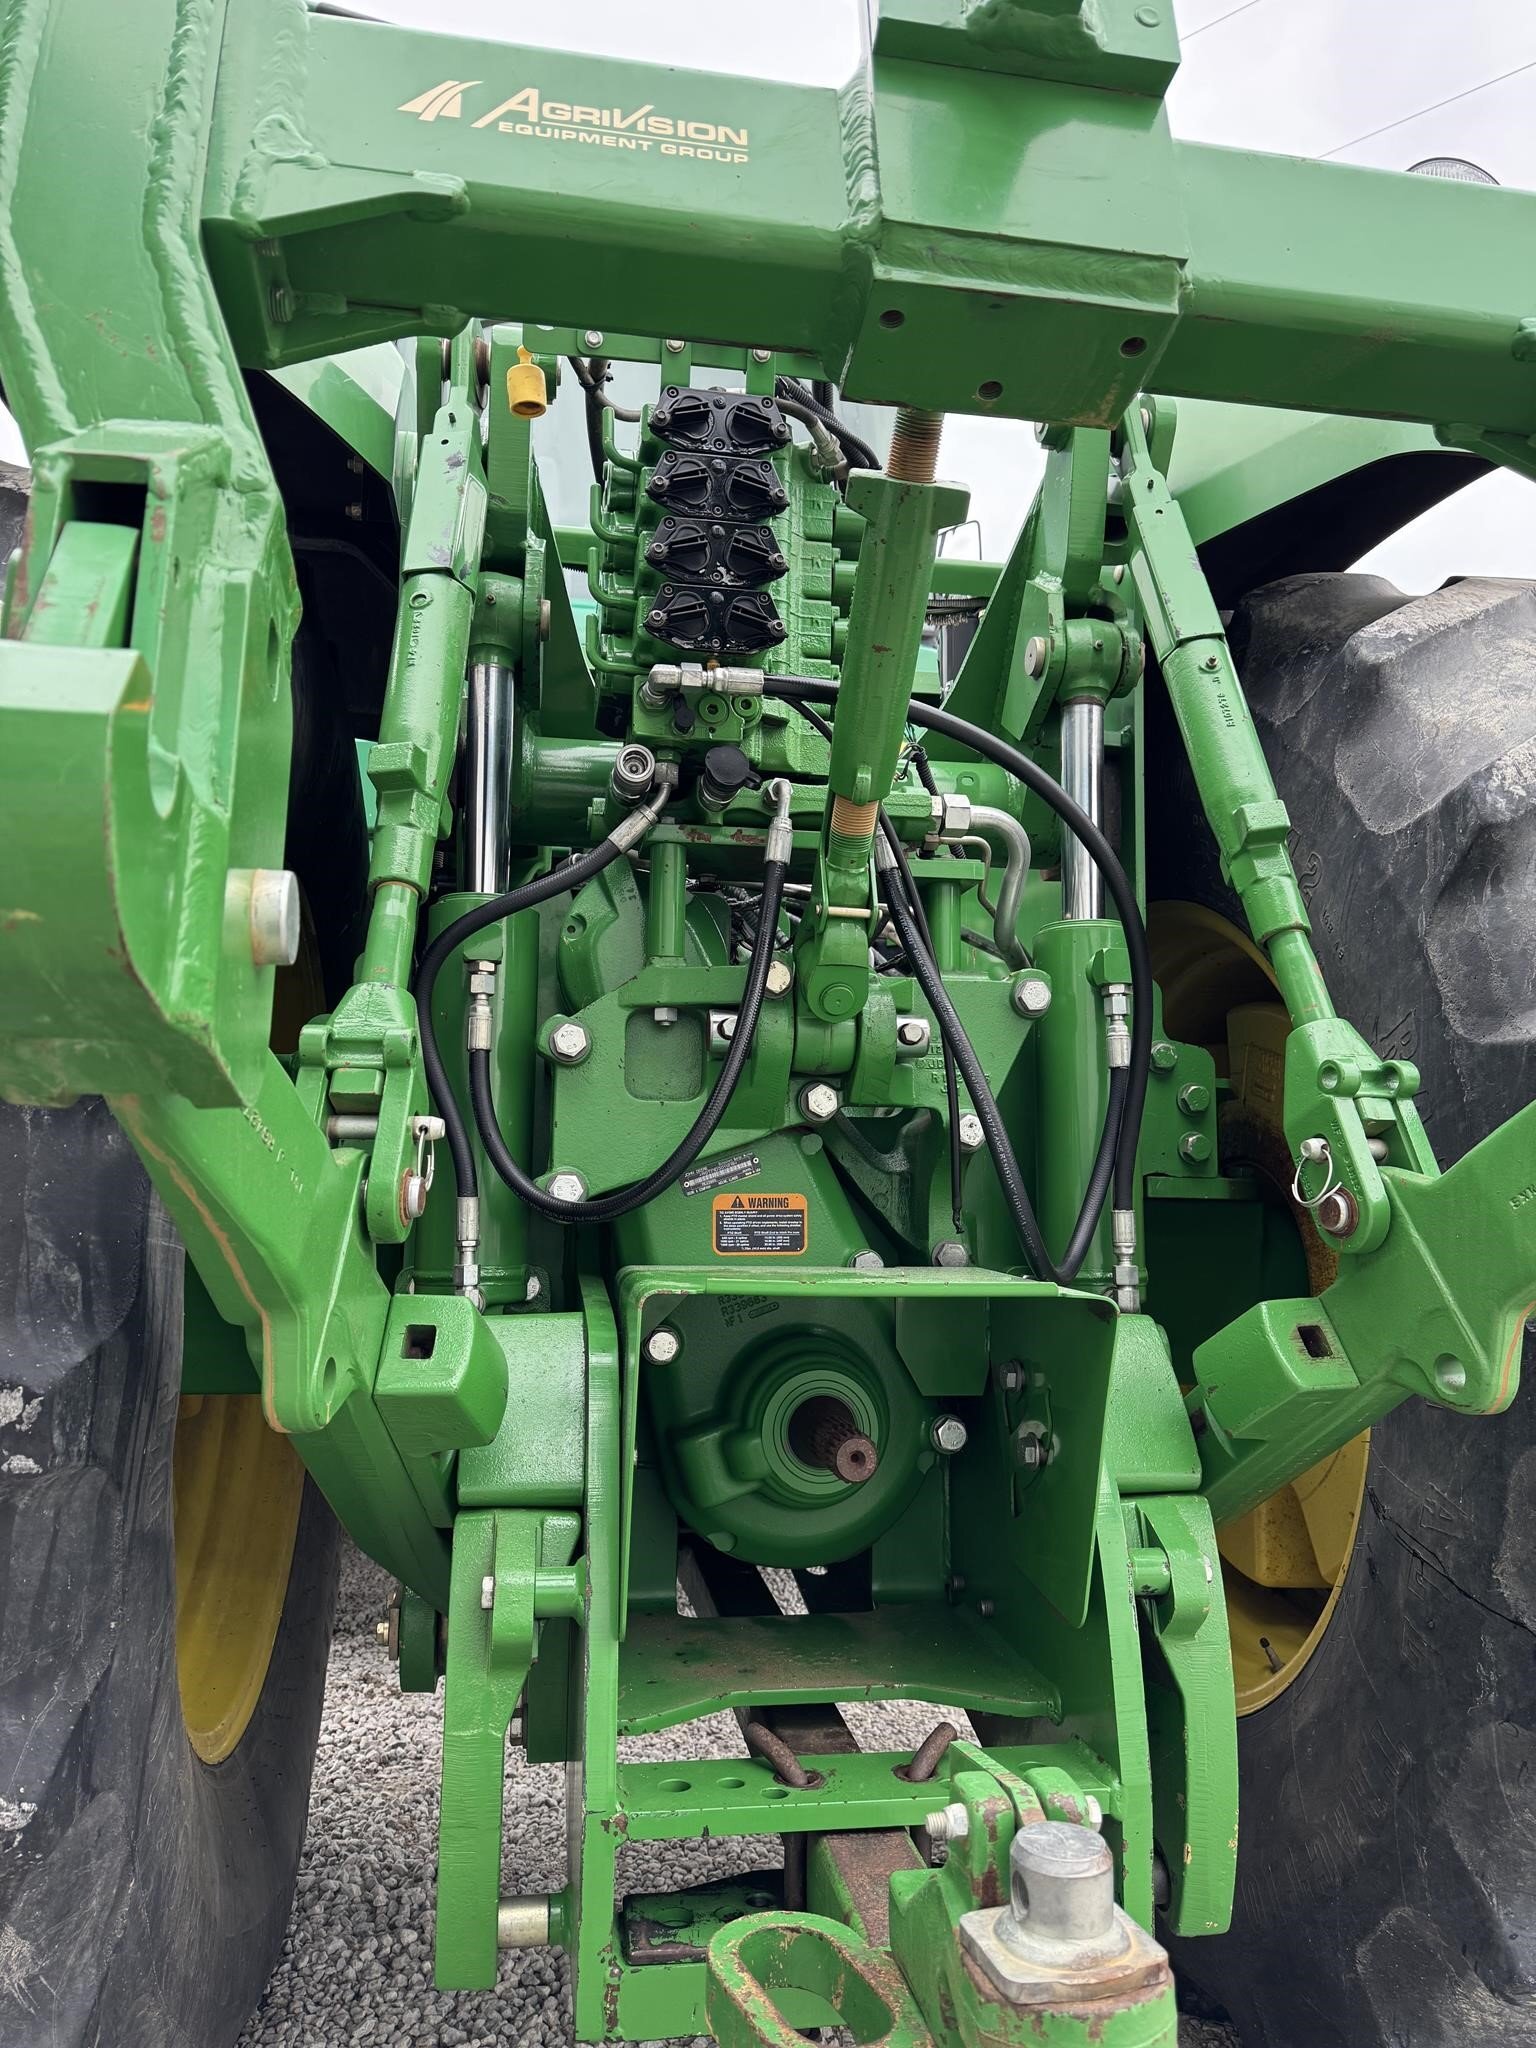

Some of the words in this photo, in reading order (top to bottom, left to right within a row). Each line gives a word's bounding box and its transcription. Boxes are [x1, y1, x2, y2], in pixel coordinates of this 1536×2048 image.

[498, 121, 653, 151] EQUIPMENT
[661, 144, 749, 164] GROUP
[748, 1198, 789, 1208] WARNING
